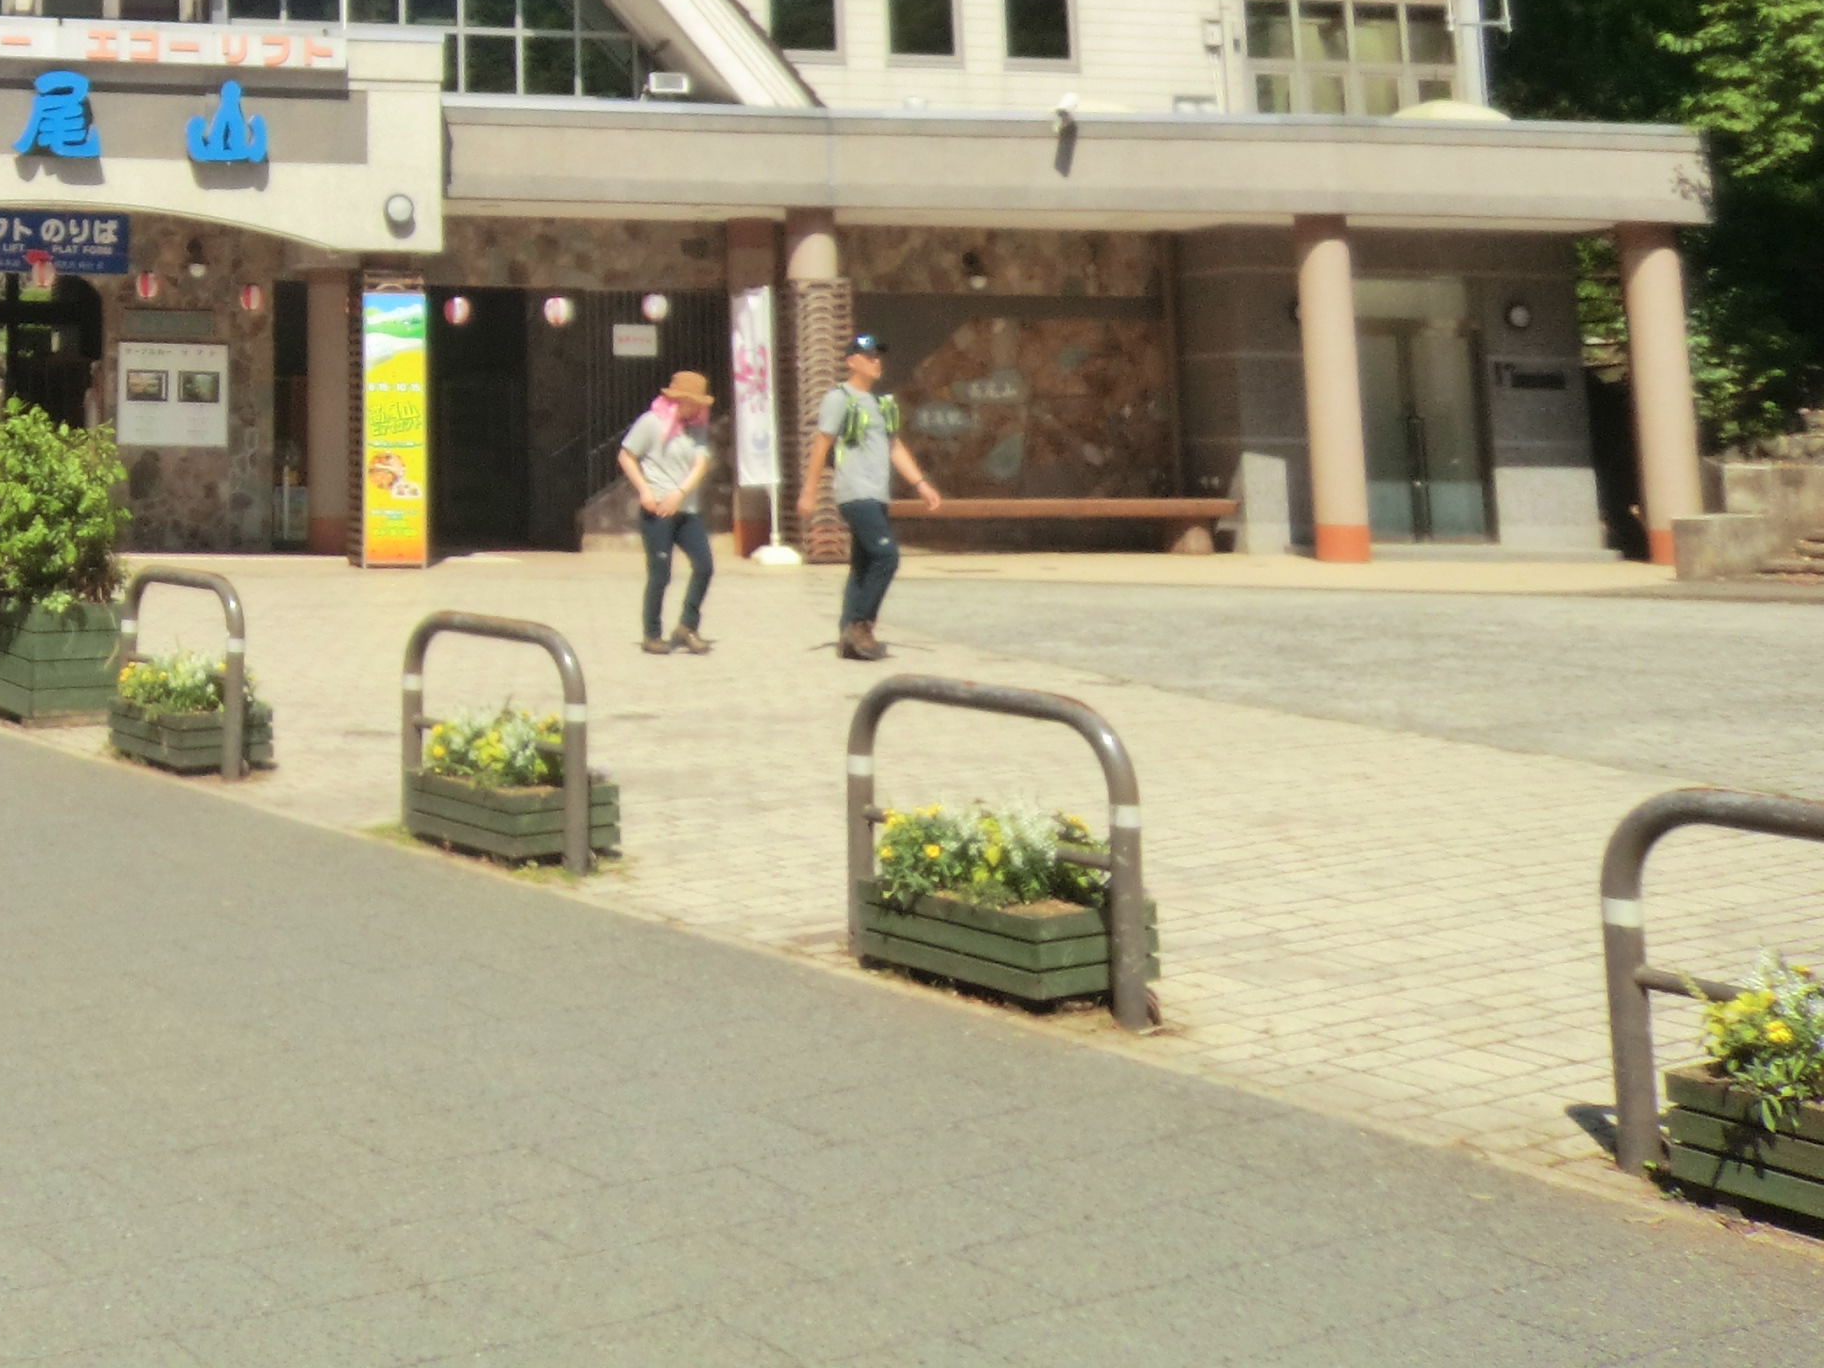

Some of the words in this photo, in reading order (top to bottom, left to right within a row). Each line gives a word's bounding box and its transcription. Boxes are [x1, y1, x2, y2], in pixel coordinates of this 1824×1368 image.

[3, 243, 25, 252] LIFT
[52, 245, 79, 255] PLAT
[83, 245, 114, 255] FORM
